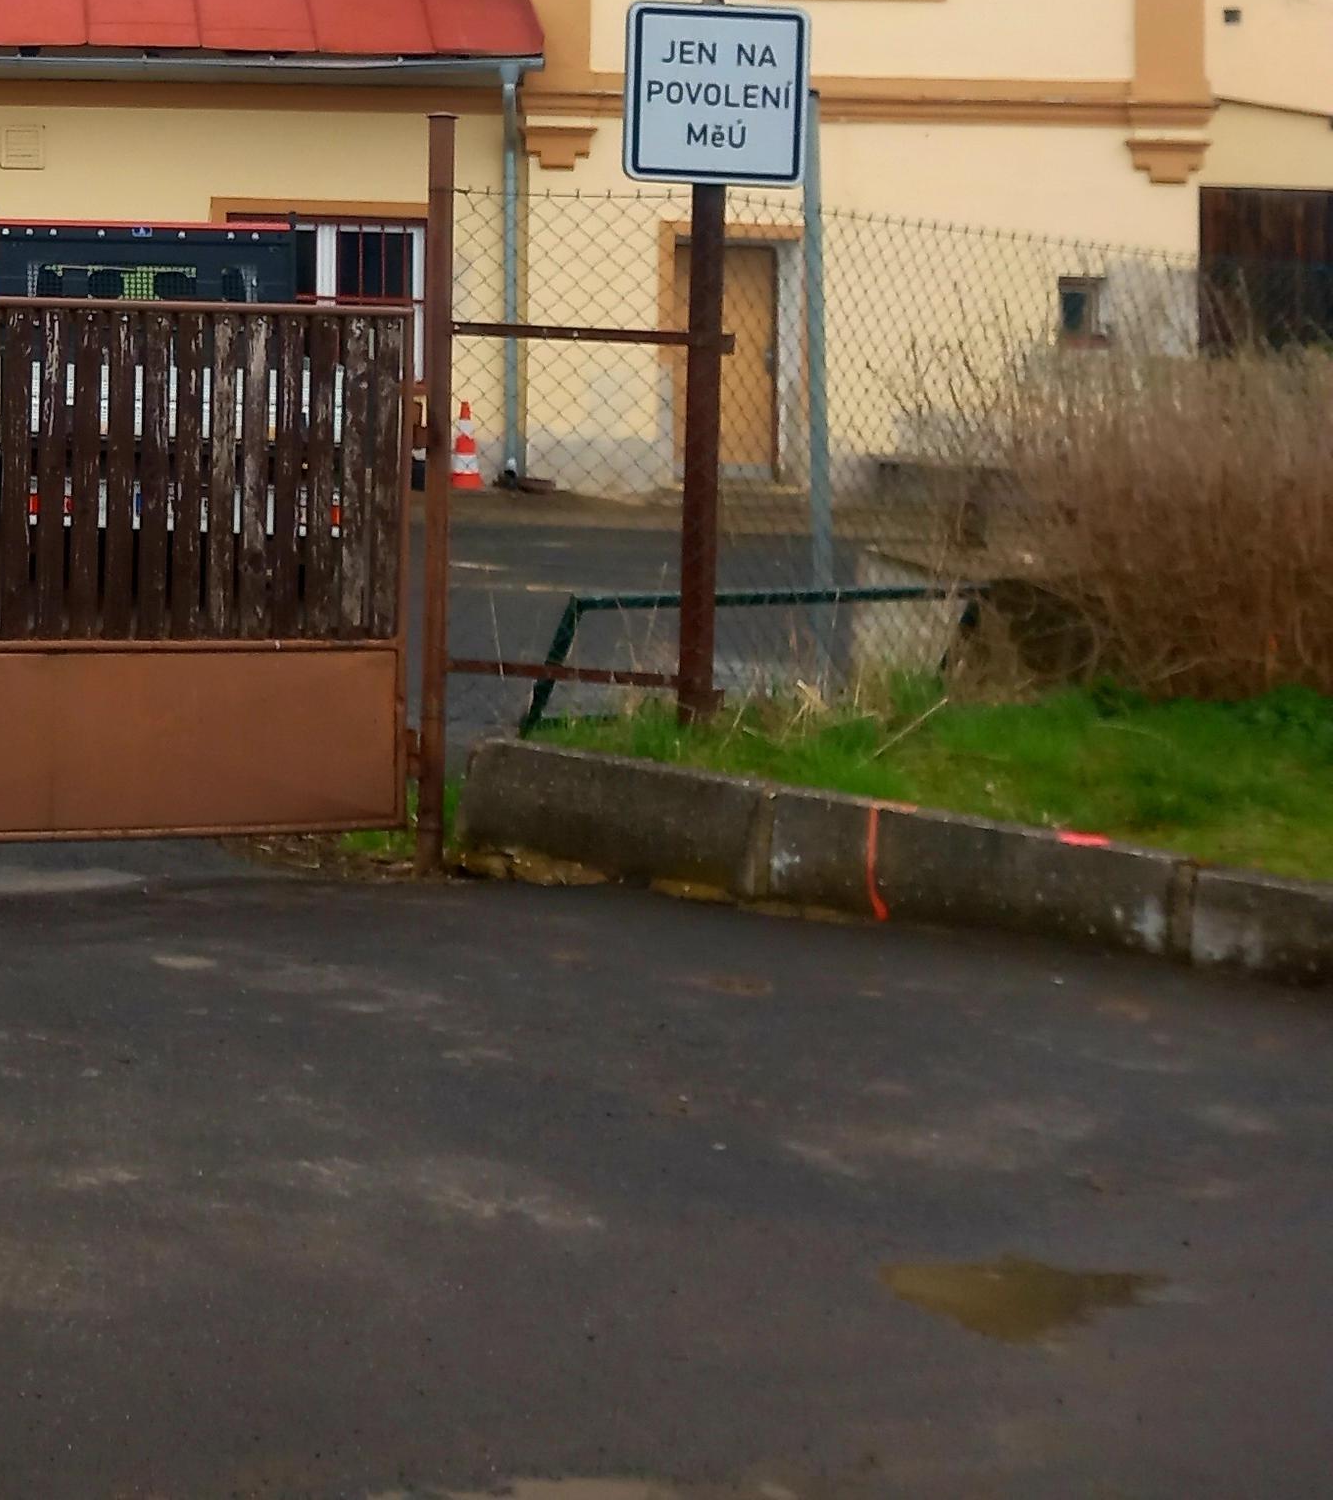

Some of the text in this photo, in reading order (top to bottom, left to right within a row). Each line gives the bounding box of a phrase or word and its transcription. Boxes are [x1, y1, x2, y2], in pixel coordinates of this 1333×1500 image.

[661, 40, 777, 68] JEN NA
[646, 80, 793, 110] POVOLENÍ
[686, 118, 747, 149] MěÚ
